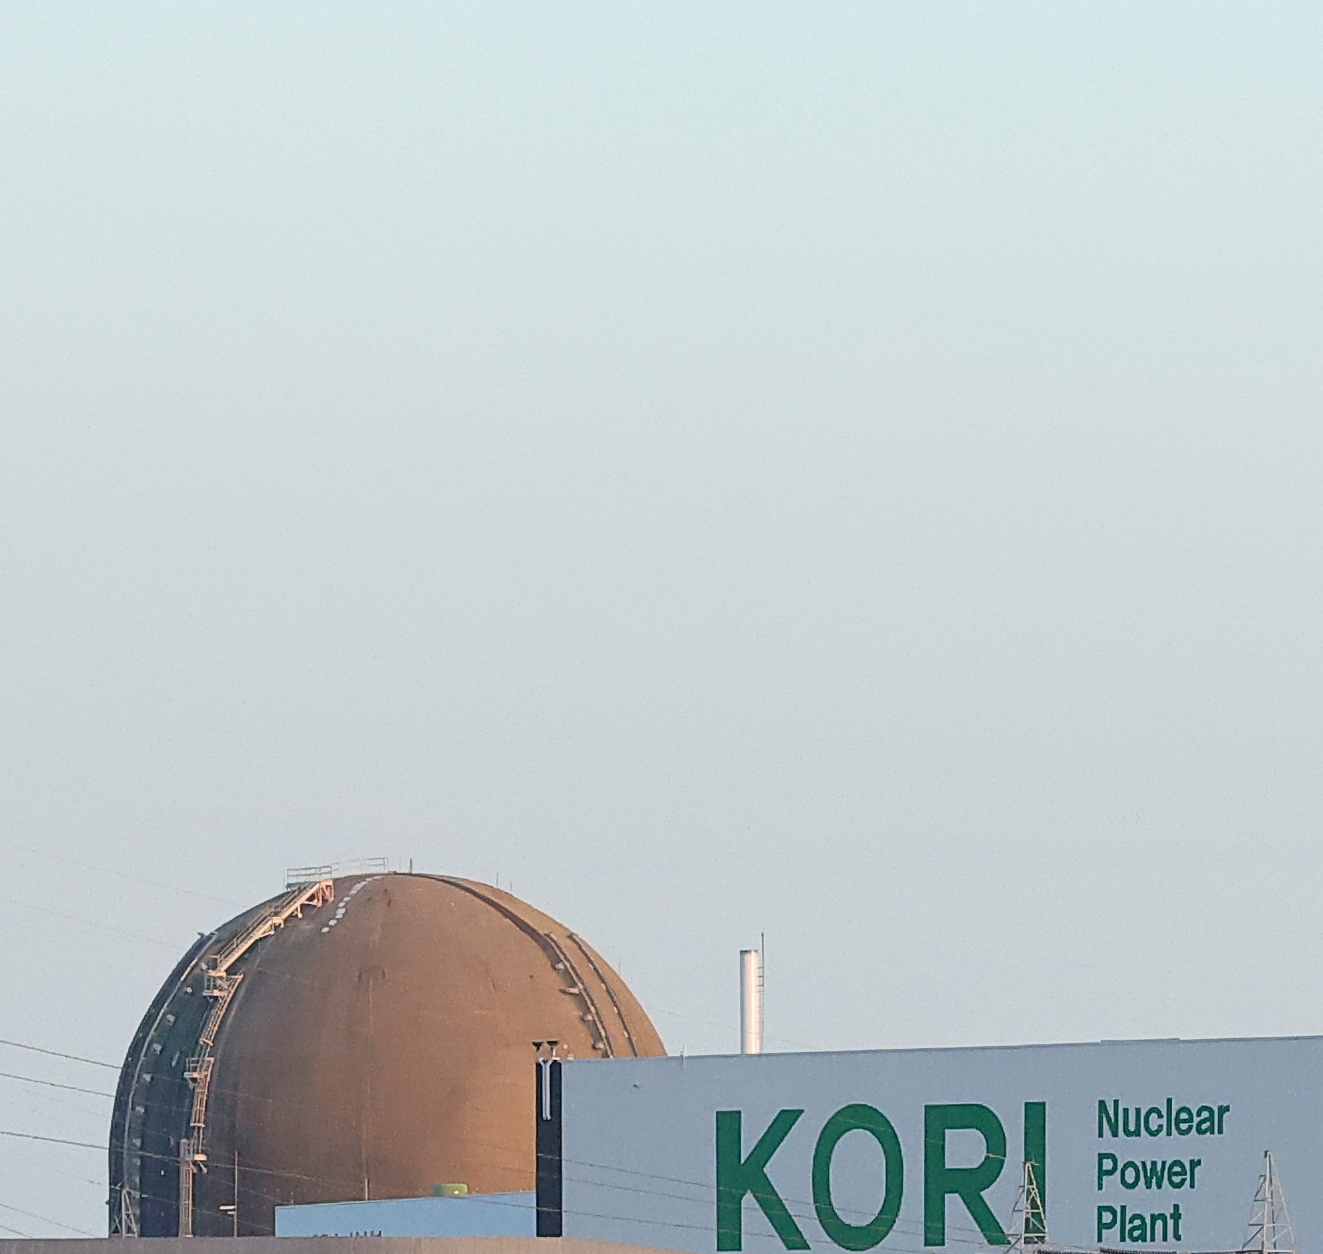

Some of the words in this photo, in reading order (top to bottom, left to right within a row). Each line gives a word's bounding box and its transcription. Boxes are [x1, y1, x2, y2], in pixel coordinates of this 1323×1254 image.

[1097, 1097, 1230, 1139] Nuclear
[715, 1101, 1046, 1252] KORI
[1097, 1152, 1202, 1191] Power
[1097, 1203, 1182, 1243] Plant
